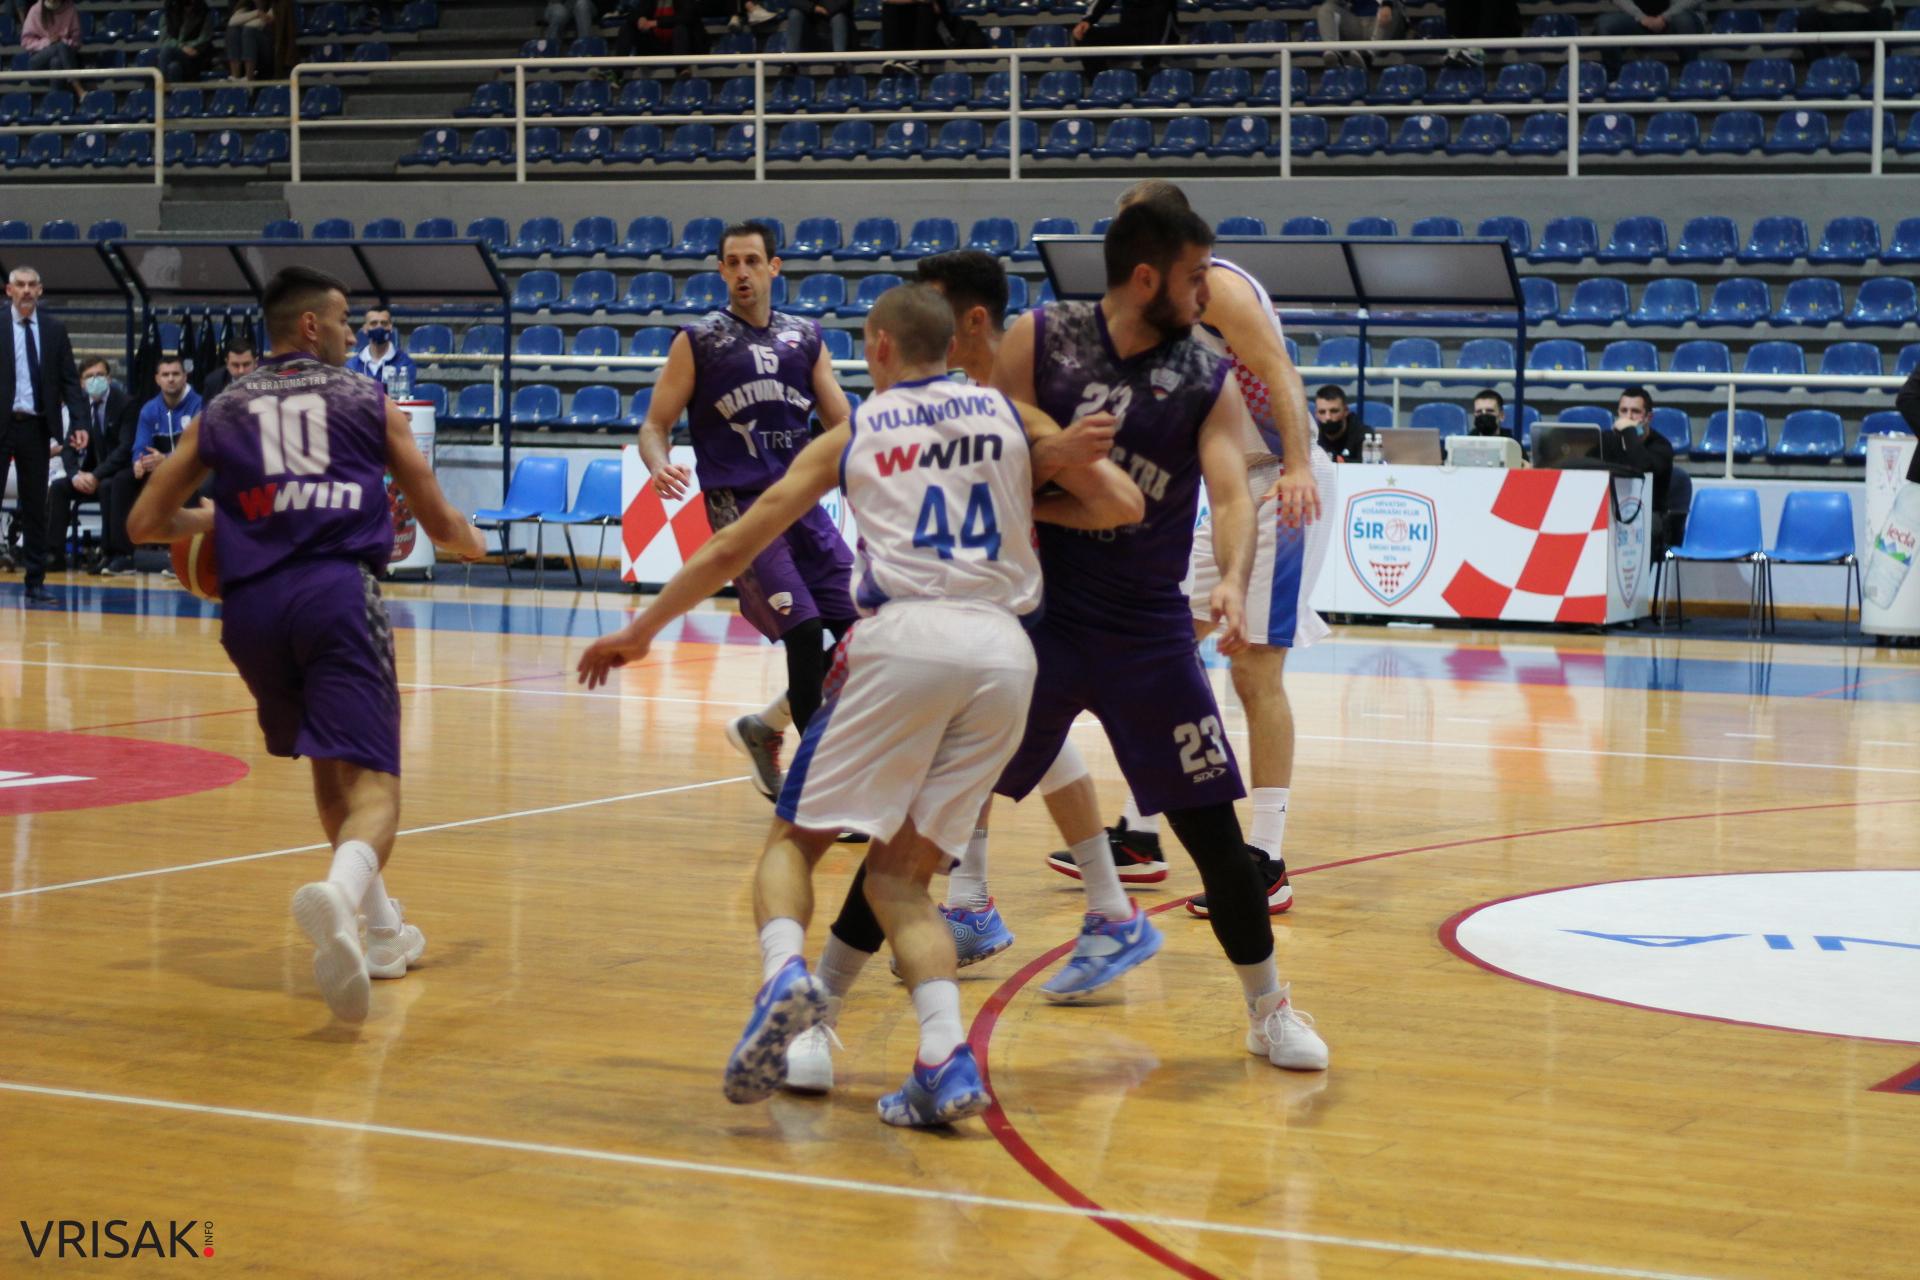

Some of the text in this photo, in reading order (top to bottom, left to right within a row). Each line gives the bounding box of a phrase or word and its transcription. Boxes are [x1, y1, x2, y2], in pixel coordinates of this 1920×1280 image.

[748, 343, 780, 375] 15
[248, 393, 331, 477] 10
[868, 395, 996, 433] VUJANOVIĆ
[912, 481, 1003, 561] 44
[1173, 714, 1228, 774] 23
